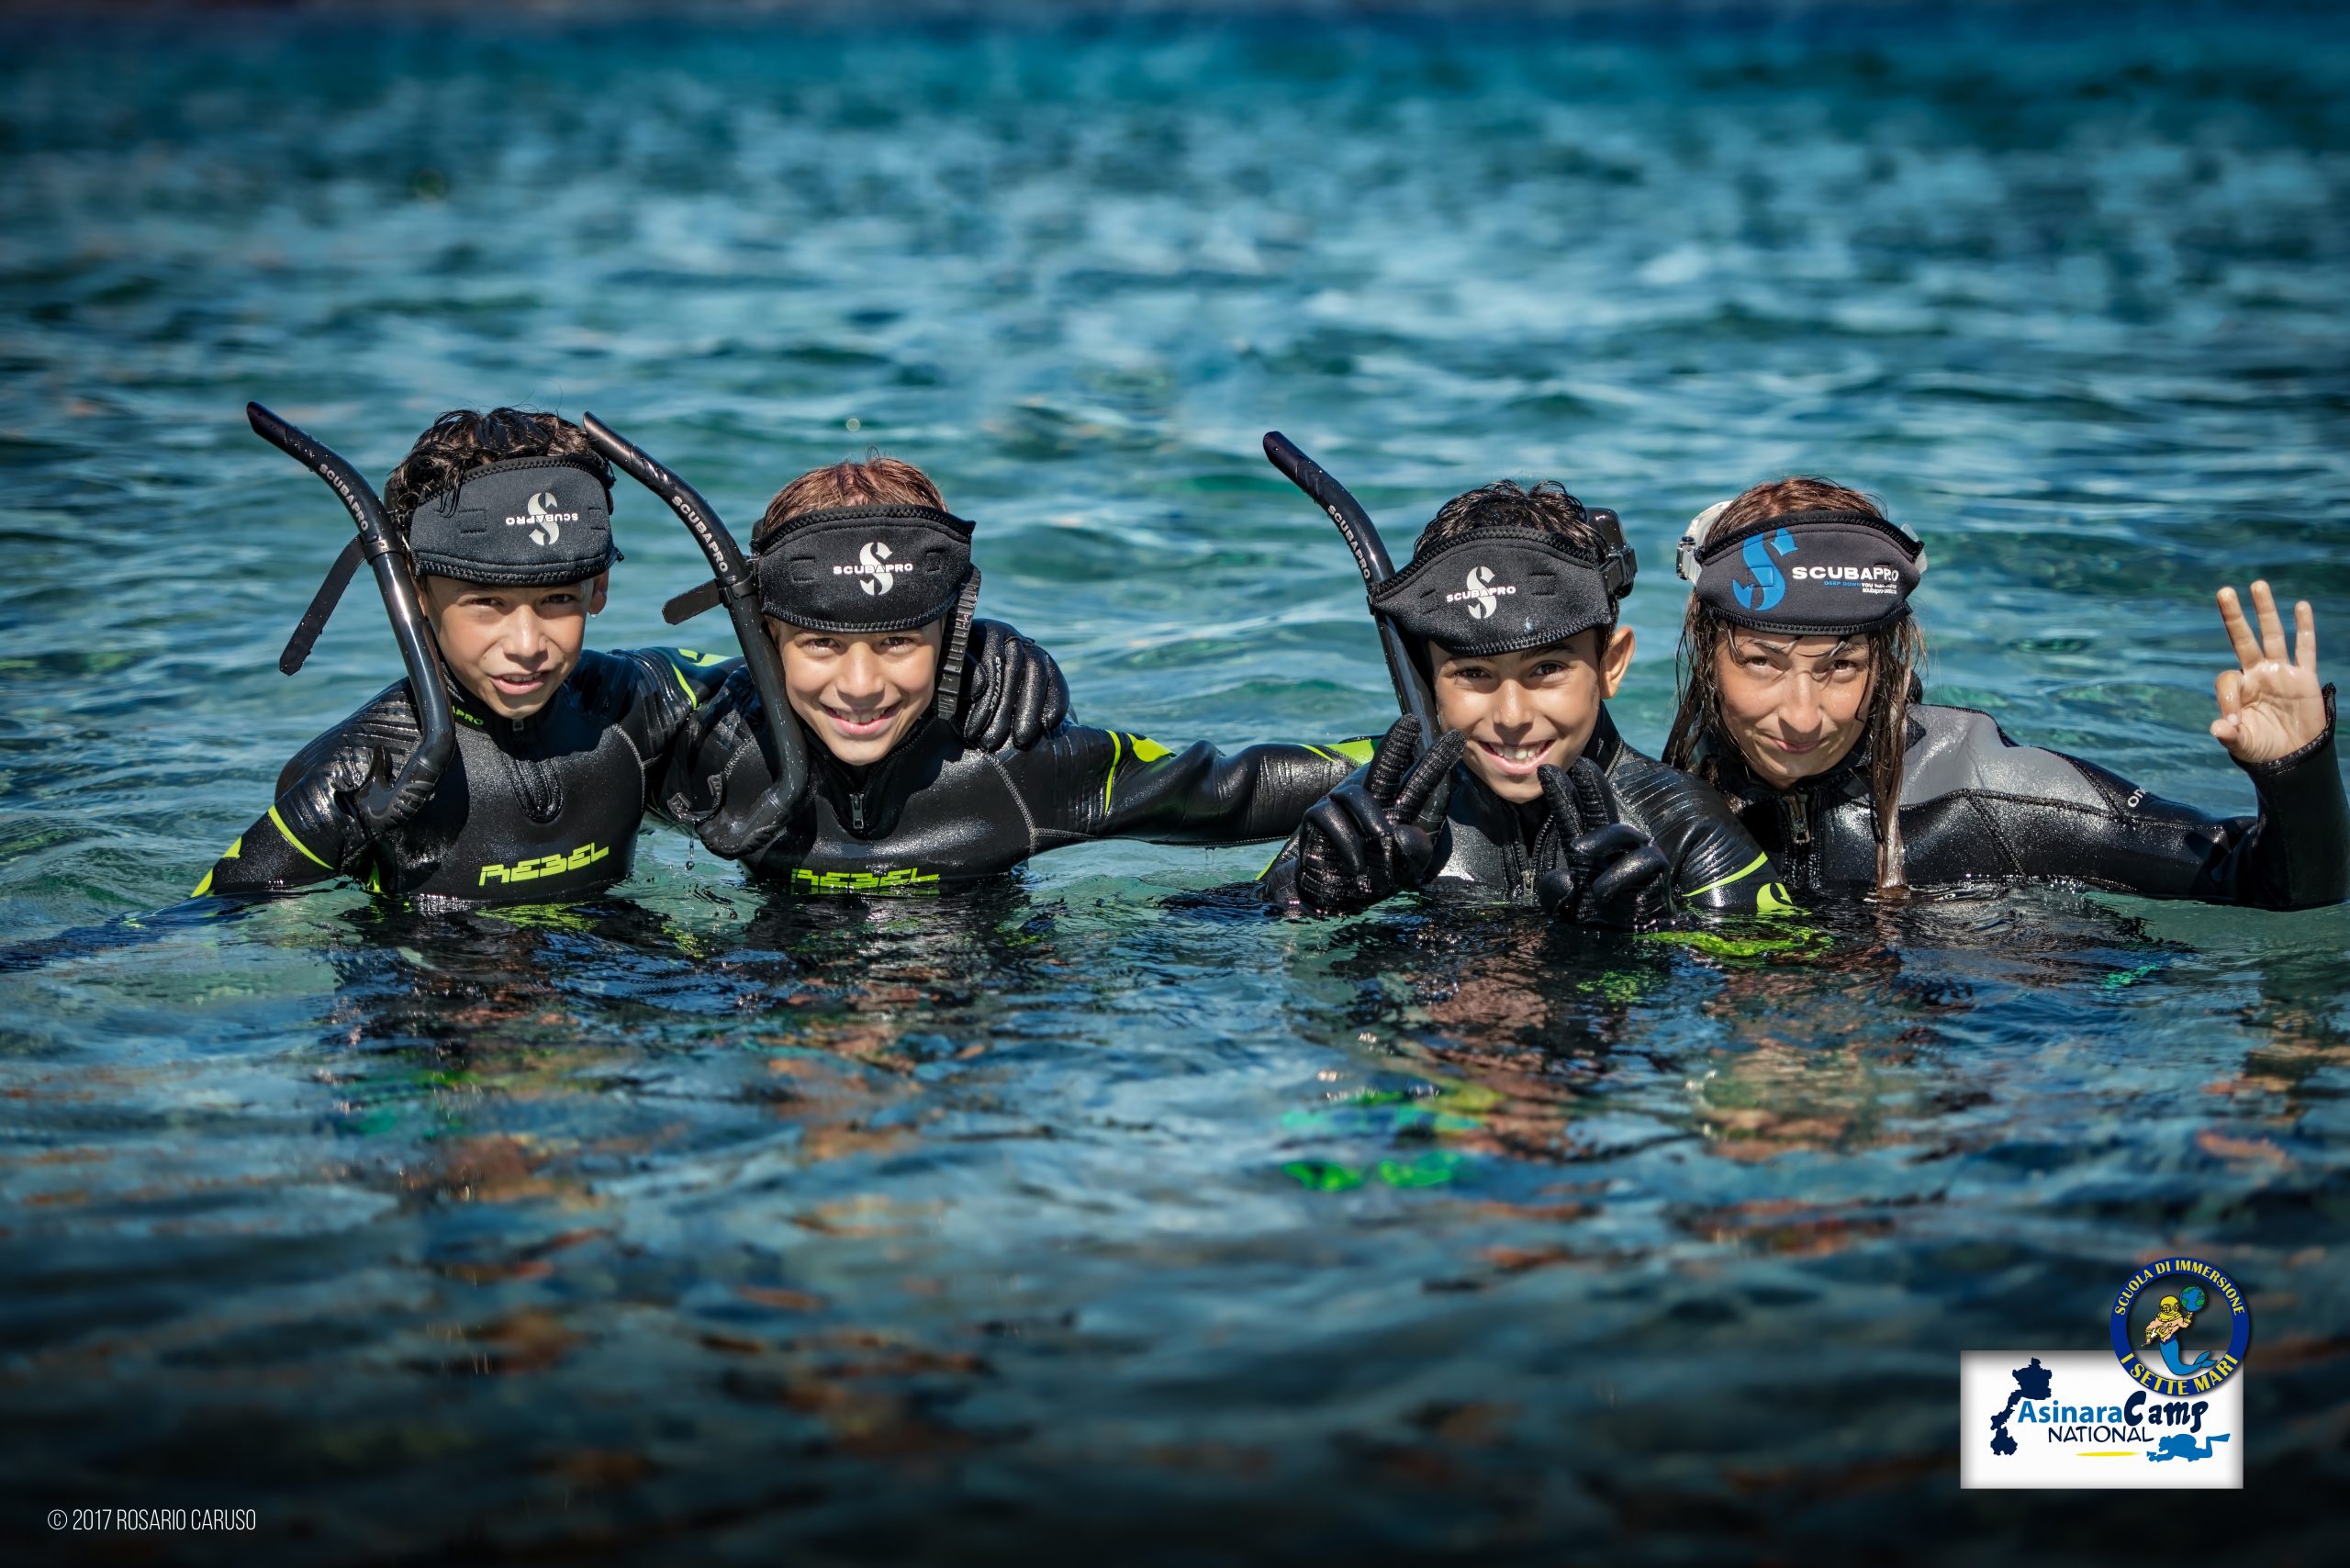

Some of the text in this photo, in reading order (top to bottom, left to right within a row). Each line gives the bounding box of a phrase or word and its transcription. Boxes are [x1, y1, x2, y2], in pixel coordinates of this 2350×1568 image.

[319, 463, 369, 532] SCUBAPRO
[505, 512, 579, 526] SCUBAPRO
[671, 495, 729, 573] SCUBAPRO
[1327, 504, 1371, 579] SCUBAPRO
[833, 565, 913, 575] SCUBAPRO
[1792, 566, 1899, 582] SCUBAPRO
[1446, 585, 1516, 602] SCUBAPRO
[479, 842, 610, 887] REBEL
[791, 868, 940, 894] REBEL
